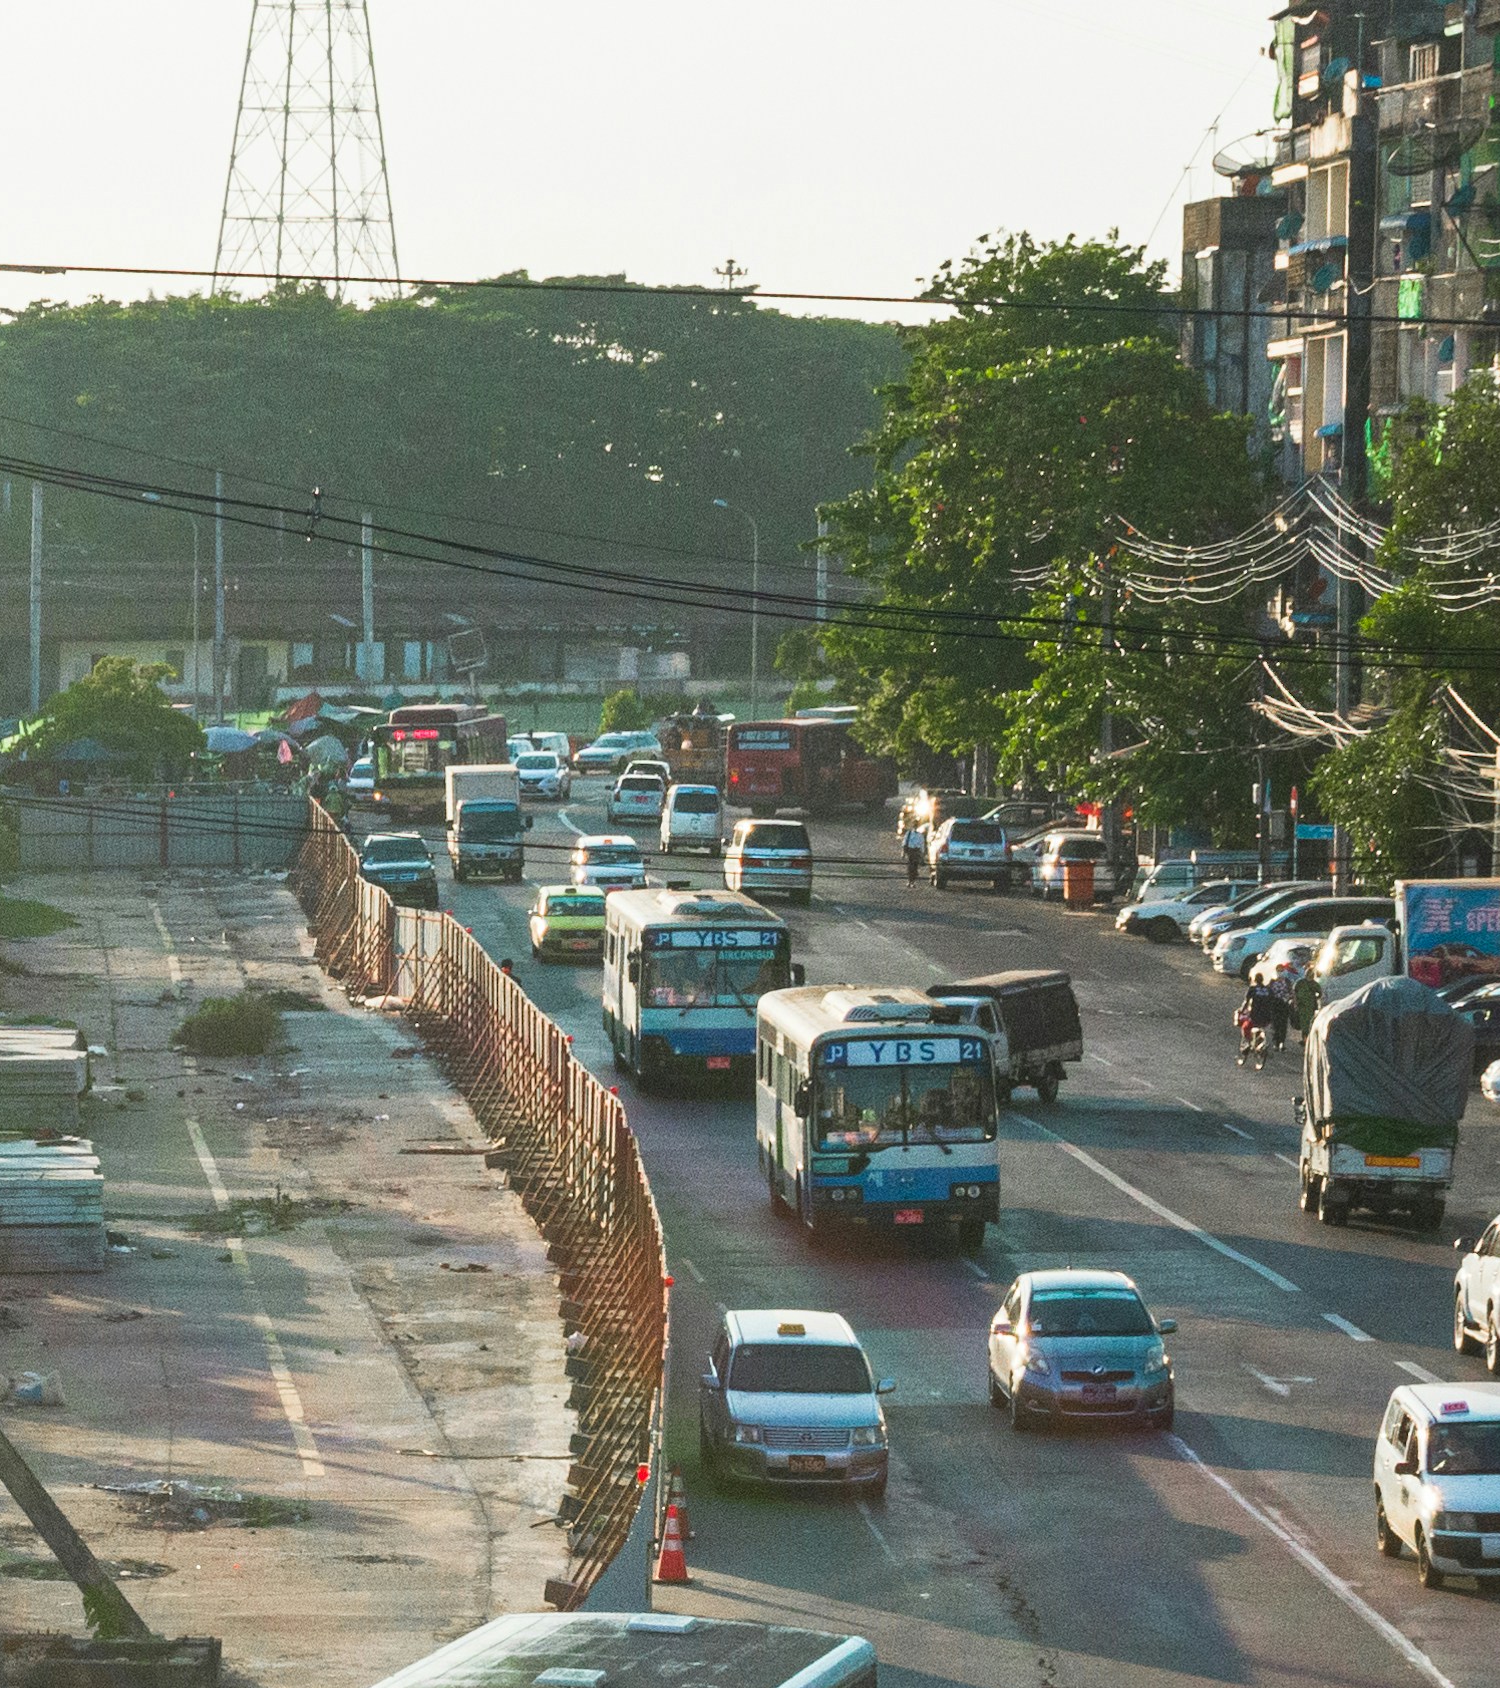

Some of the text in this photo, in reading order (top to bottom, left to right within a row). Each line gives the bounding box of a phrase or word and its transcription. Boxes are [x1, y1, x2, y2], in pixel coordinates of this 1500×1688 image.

[695, 931, 738, 947] YBS
[762, 931, 778, 946] 21
[869, 1041, 936, 1064] YBS
[962, 1042, 982, 1060] 21
